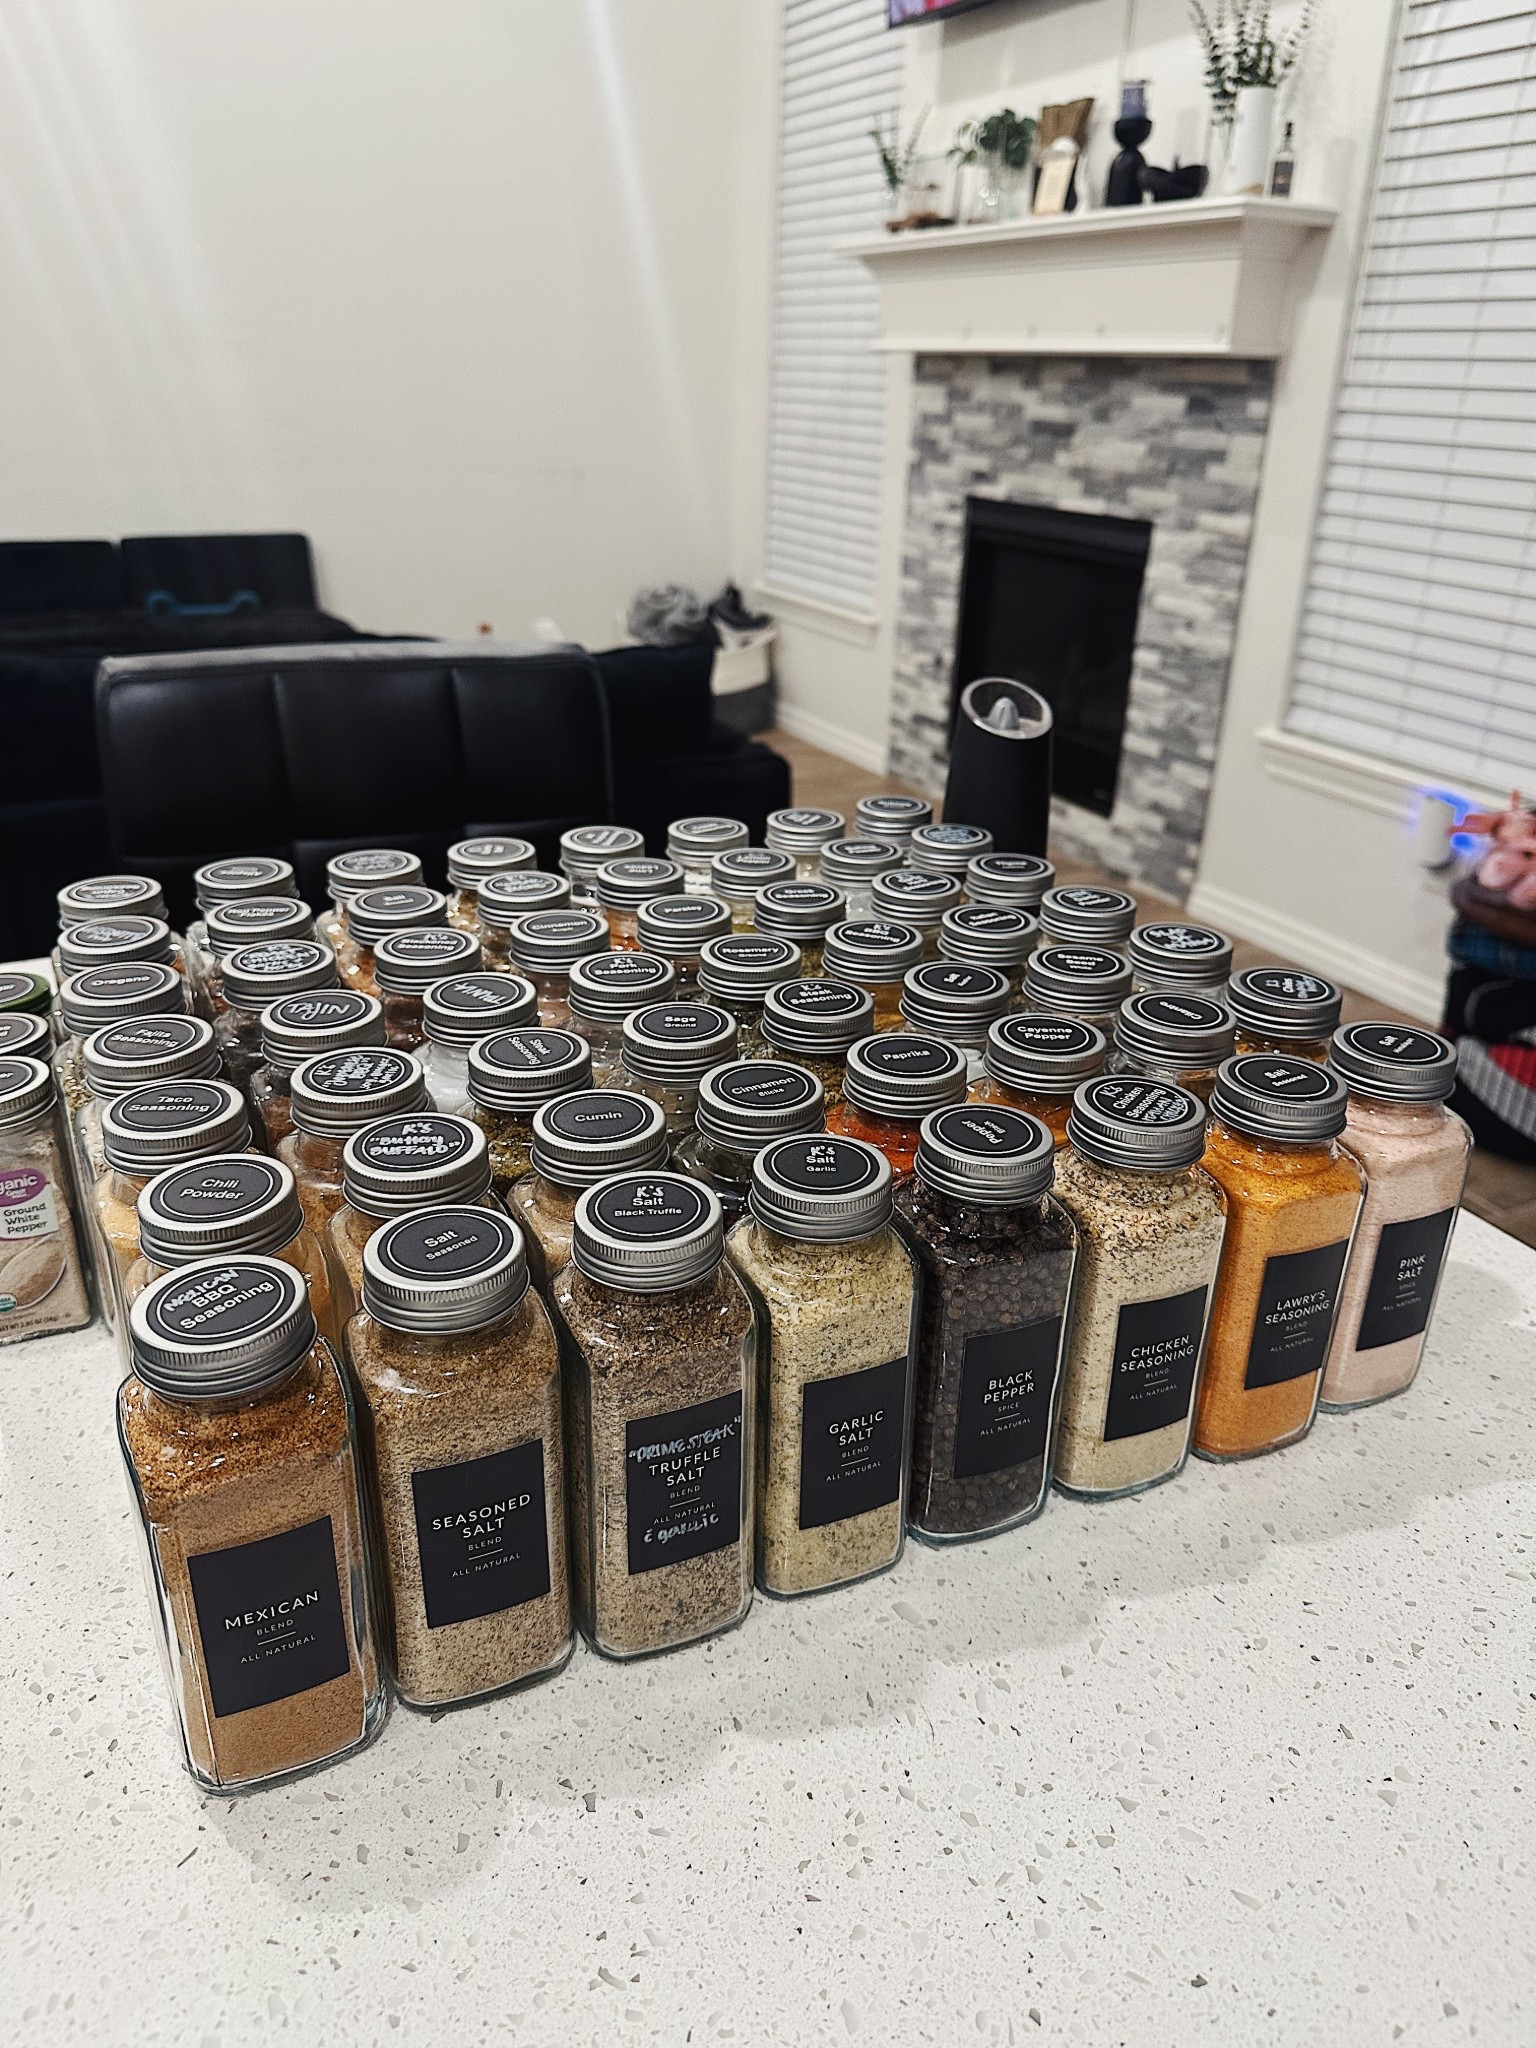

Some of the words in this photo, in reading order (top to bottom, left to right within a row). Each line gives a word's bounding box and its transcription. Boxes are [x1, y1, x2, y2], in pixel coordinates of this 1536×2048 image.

[251, 907, 290, 915] Pepper
[663, 905, 703, 913] Parsley
[532, 920, 588, 930] Cinnamon
[845, 929, 901, 944] Seasoning
[397, 943, 455, 951] Seasoning
[1057, 953, 1104, 962] Sesame
[1066, 959, 1097, 967] Seed
[594, 967, 657, 976] Seasoning
[91, 975, 151, 987] Oregano
[790, 993, 853, 1005] Seasoning
[799, 989, 832, 997] Steak
[286, 1002, 351, 1020] TAJIN
[1159, 1000, 1204, 1020] Cilantro
[135, 1028, 172, 1038] Fajita
[1017, 1026, 1073, 1035] Cayenne
[1024, 1032, 1071, 1041] Pepper
[111, 1034, 180, 1048] Seasoning
[529, 1038, 552, 1055] Steak
[1378, 1035, 1398, 1046] Salt
[508, 1036, 541, 1065] Seasoning
[882, 1049, 931, 1061] Paprika
[1264, 1067, 1292, 1079] Salt
[1271, 1073, 1309, 1088] Seasoned
[731, 1075, 796, 1096] Cinnamon
[757, 1087, 785, 1098] Sticks
[158, 1096, 194, 1104] Taco
[1112, 1086, 1145, 1109] Chicken
[1125, 1088, 1167, 1118] Seasoning
[129, 1103, 211, 1113] Seasoning
[574, 1111, 623, 1122] Cumin
[961, 1120, 1004, 1144] Pepper
[983, 1120, 1007, 1134] Black
[805, 1155, 836, 1164] Salt
[201, 1178, 240, 1188] Chili
[179, 1188, 245, 1200] Powder
[632, 1197, 664, 1206] Salt
[3, 1202, 48, 1217] Ground
[614, 1209, 646, 1217] Black
[647, 1208, 682, 1216] Truffle
[5, 1214, 41, 1226] White
[7, 1220, 48, 1234] Pepper
[424, 1230, 459, 1248] Salt
[425, 1235, 479, 1260] Seasoned
[1399, 1253, 1426, 1269] PINK
[1396, 1265, 1423, 1281] SALT
[191, 1282, 238, 1309] BBQ
[1276, 1289, 1326, 1311] LAWRY'S
[180, 1281, 275, 1330] Seasoning
[1264, 1299, 1330, 1325] SEASONING
[1285, 1320, 1308, 1332] BLEND
[1131, 1334, 1190, 1358] CHICKEN
[1284, 1336, 1315, 1349] NATURAL
[1120, 1344, 1194, 1372] SEASONING
[988, 1369, 1034, 1390] BLACK
[1145, 1367, 1170, 1379] BLEND
[983, 1382, 1034, 1404] PEPPER
[1146, 1383, 1178, 1397] NATURAL
[997, 1401, 1020, 1413] SPICE
[828, 1410, 884, 1435] GARLIC
[980, 1428, 994, 1436] ALL
[997, 1417, 1031, 1432] NATURAL
[838, 1427, 874, 1446] SALT
[841, 1445, 870, 1459] BLEND
[648, 1446, 721, 1477] TRUFFLE
[666, 1465, 706, 1487] SALT
[826, 1474, 841, 1482] ALL
[844, 1460, 882, 1477] NATURAL
[669, 1484, 701, 1499] BLEND
[432, 1493, 531, 1530] SEASONED
[653, 1515, 671, 1525] ALL
[674, 1501, 716, 1520] NATURAL
[462, 1516, 505, 1539] SALT
[468, 1536, 502, 1551] BLEND
[451, 1567, 471, 1578] ALL
[474, 1552, 521, 1572] NATURAL
[224, 1590, 319, 1630] MEXICAN
[256, 1619, 294, 1636] BLEND
[240, 1653, 261, 1664] ALL
[265, 1634, 316, 1657] NATURAL
